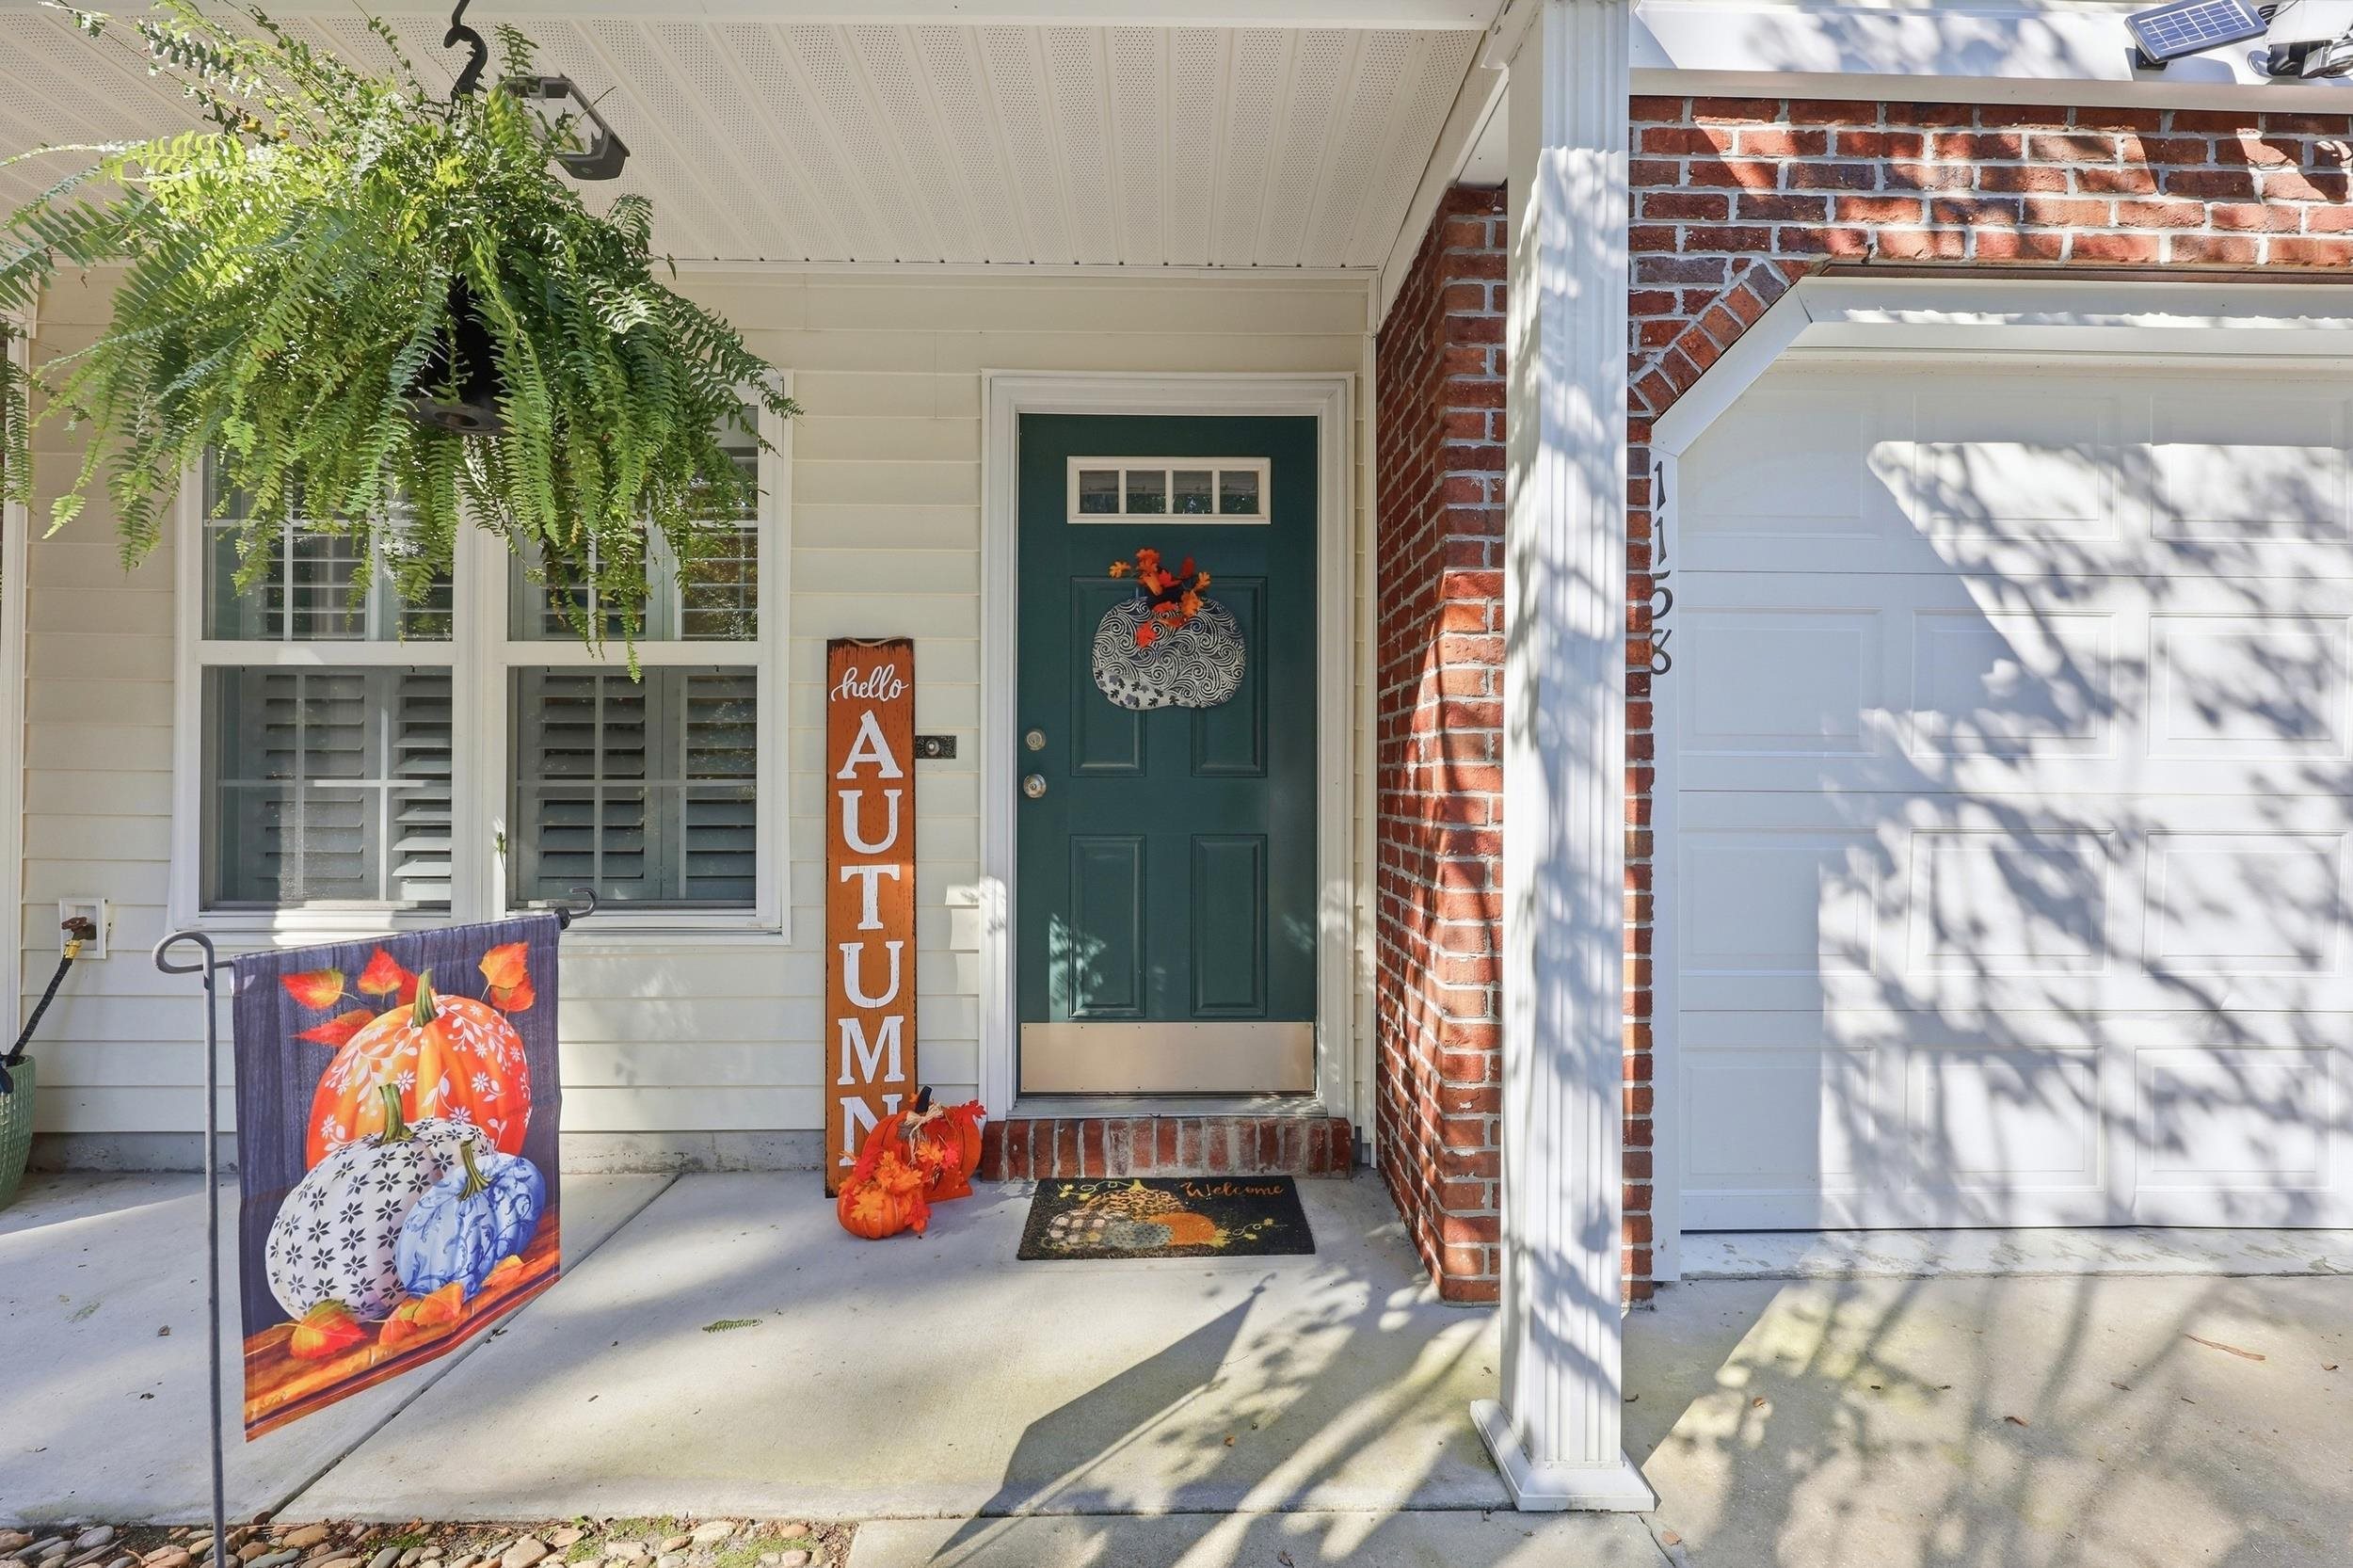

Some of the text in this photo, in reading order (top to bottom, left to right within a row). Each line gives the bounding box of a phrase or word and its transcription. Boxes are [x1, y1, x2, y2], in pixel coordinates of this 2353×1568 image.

[1649, 460, 1673, 675] 1158
[830, 663, 909, 702] hello
[1180, 1181, 1284, 1198] Welcome
